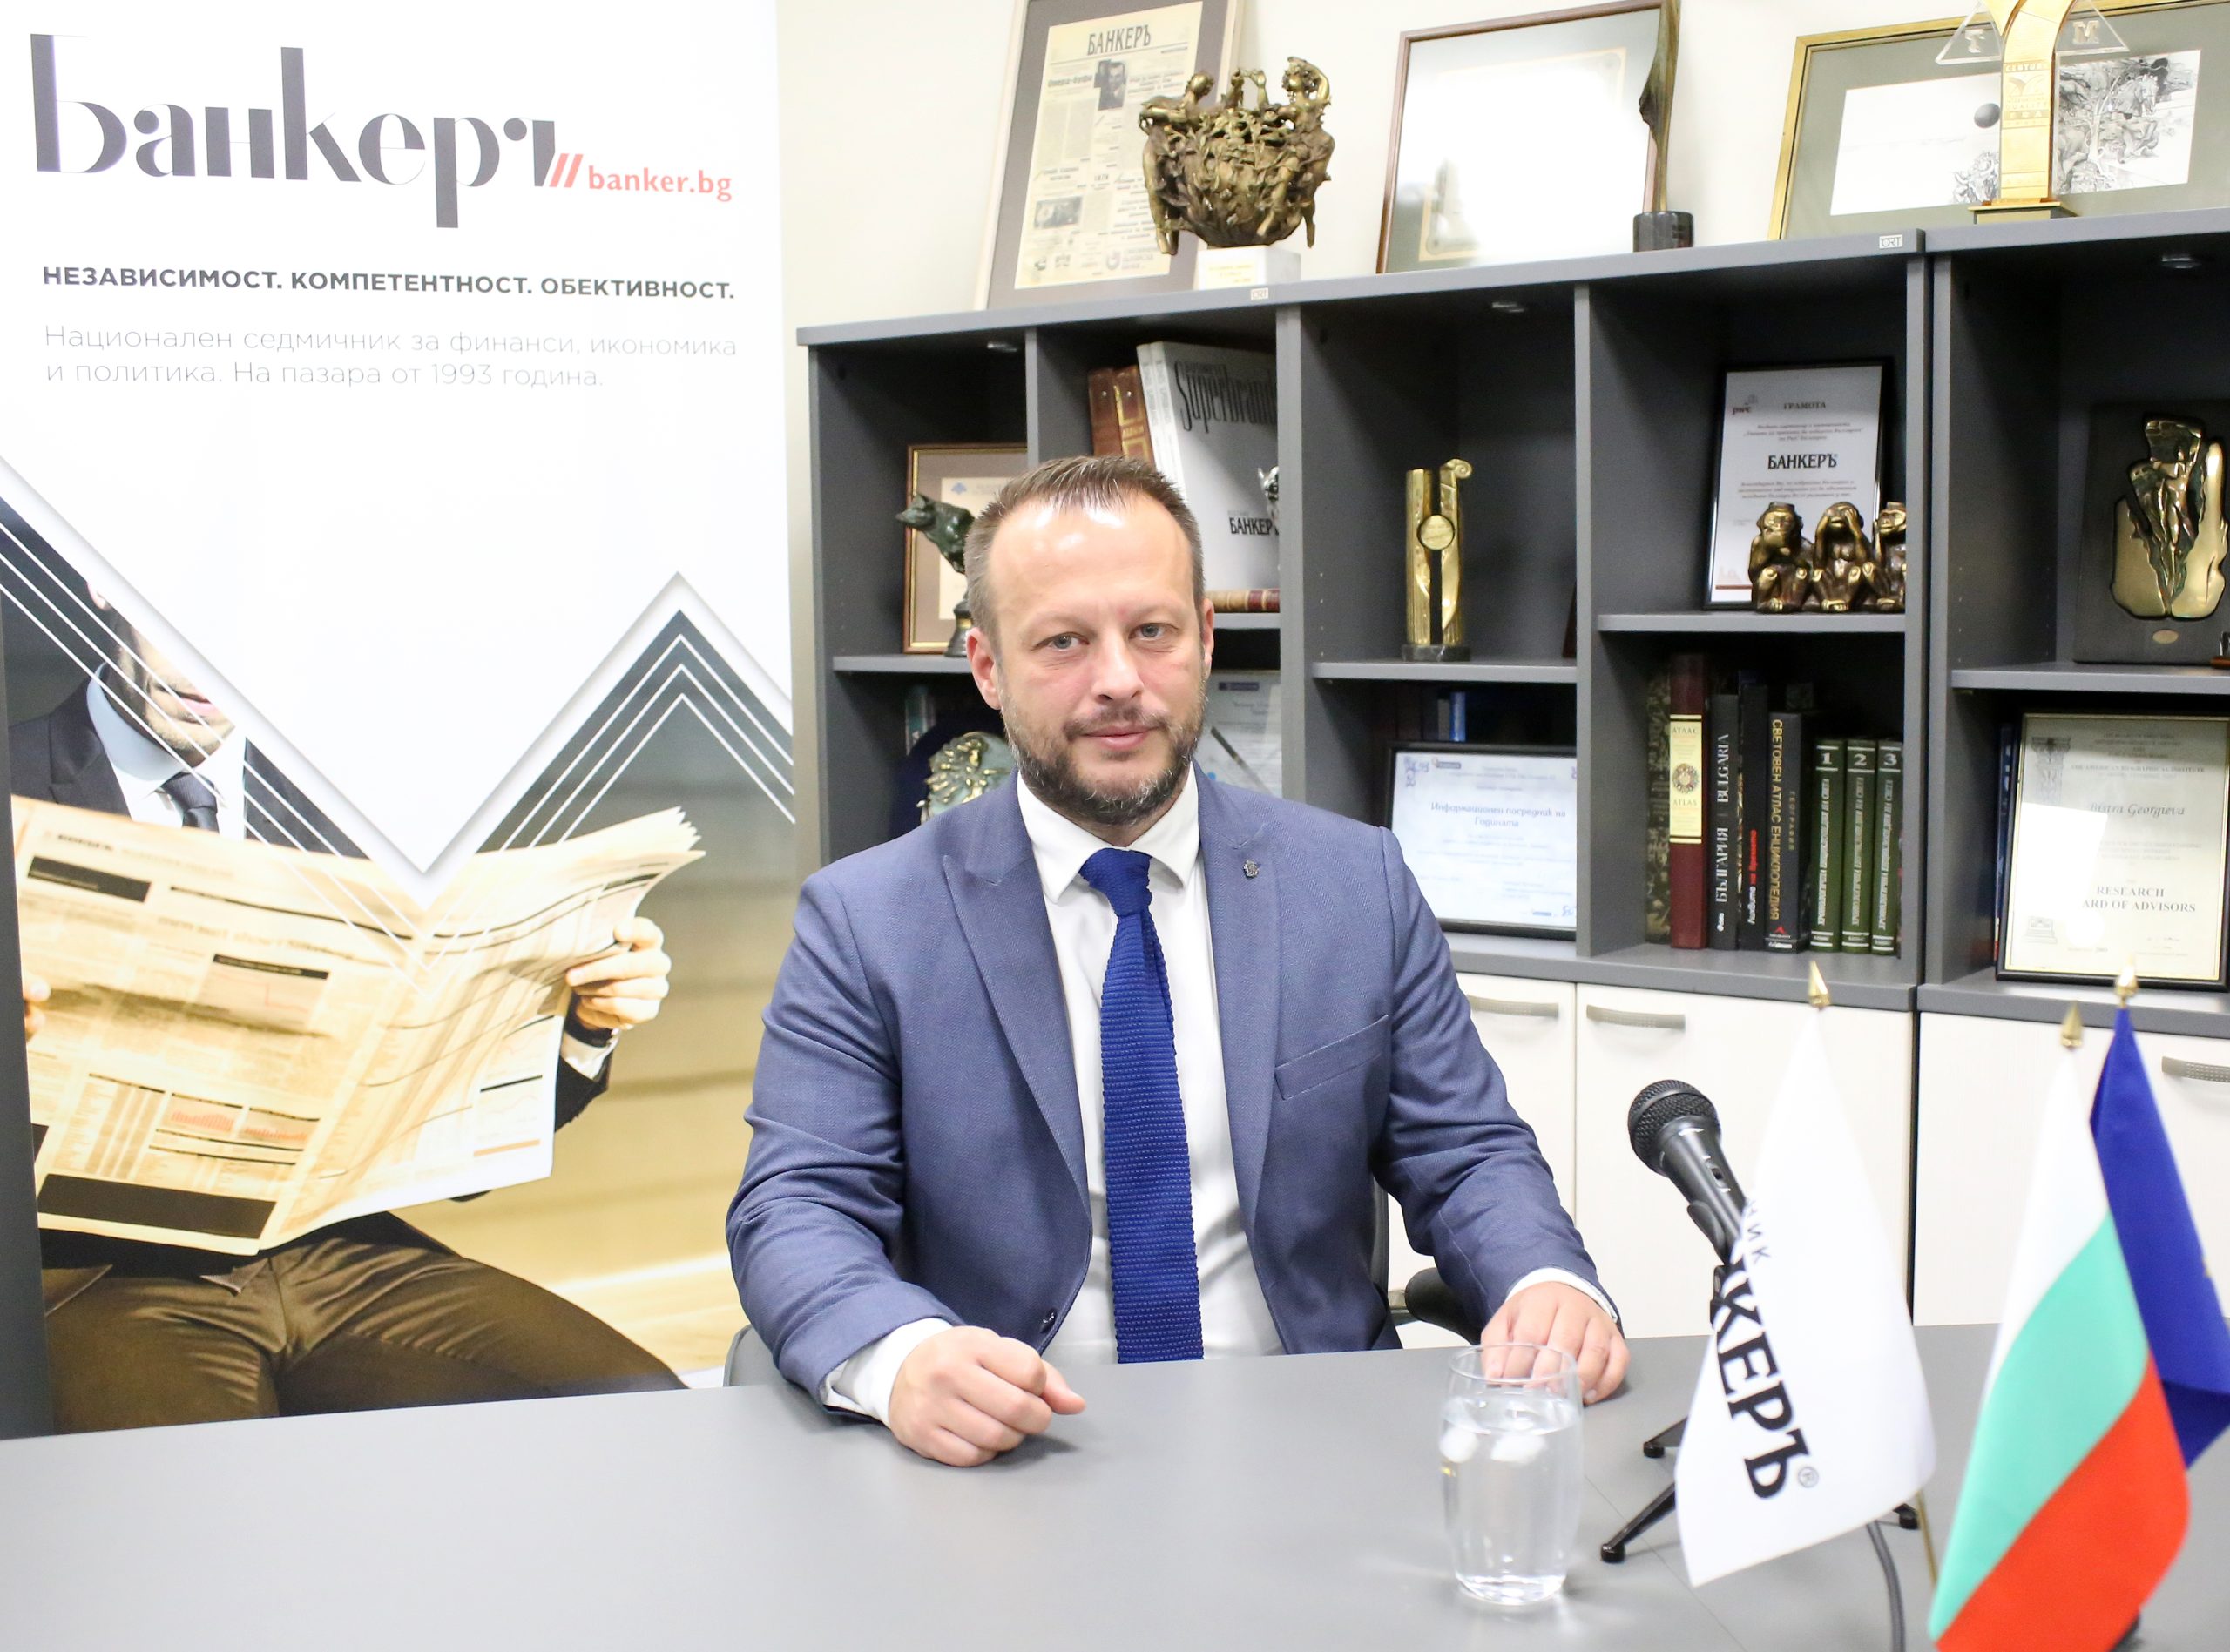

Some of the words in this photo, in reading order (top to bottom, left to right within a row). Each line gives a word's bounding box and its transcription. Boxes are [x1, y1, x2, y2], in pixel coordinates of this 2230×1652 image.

[1087, 25, 1152, 56] БАНКЕРЪ
[43, 266, 283, 289] НЕЗАВИСИМОСТ.
[291, 272, 533, 294] КОМПЕТЕНТНОСТ.
[540, 277, 735, 300] ОБЕКТИВНОСТ.
[45, 325, 233, 350] Национален
[243, 331, 401, 353] седмичник
[410, 334, 440, 352] за
[449, 331, 580, 355] финанси,
[590, 336, 737, 356] икономика
[46, 365, 64, 382] и
[76, 365, 223, 383] политика.
[234, 361, 270, 383] На
[282, 367, 382, 388] пазара
[391, 367, 422, 385] от
[430, 363, 493, 385] 1993
[503, 367, 604, 389] година.
[1767, 453, 1837, 470] БАНКЕРЪ
[1229, 516, 1279, 536] БАНКЕР
[1771, 719, 1783, 782] СВЕТОВЕН
[1821, 752, 1833, 765] 1
[1853, 753, 1868, 766] 2
[1883, 753, 1897, 766] 3
[1716, 733, 1729, 803] BULGARIA
[1771, 784, 1782, 823] АТЛАС
[1715, 827, 1729, 903] БЪЛГАРИЯ
[2096, 886, 2165, 898] RESEARCH
[2132, 901, 2196, 912] ADVISORS
